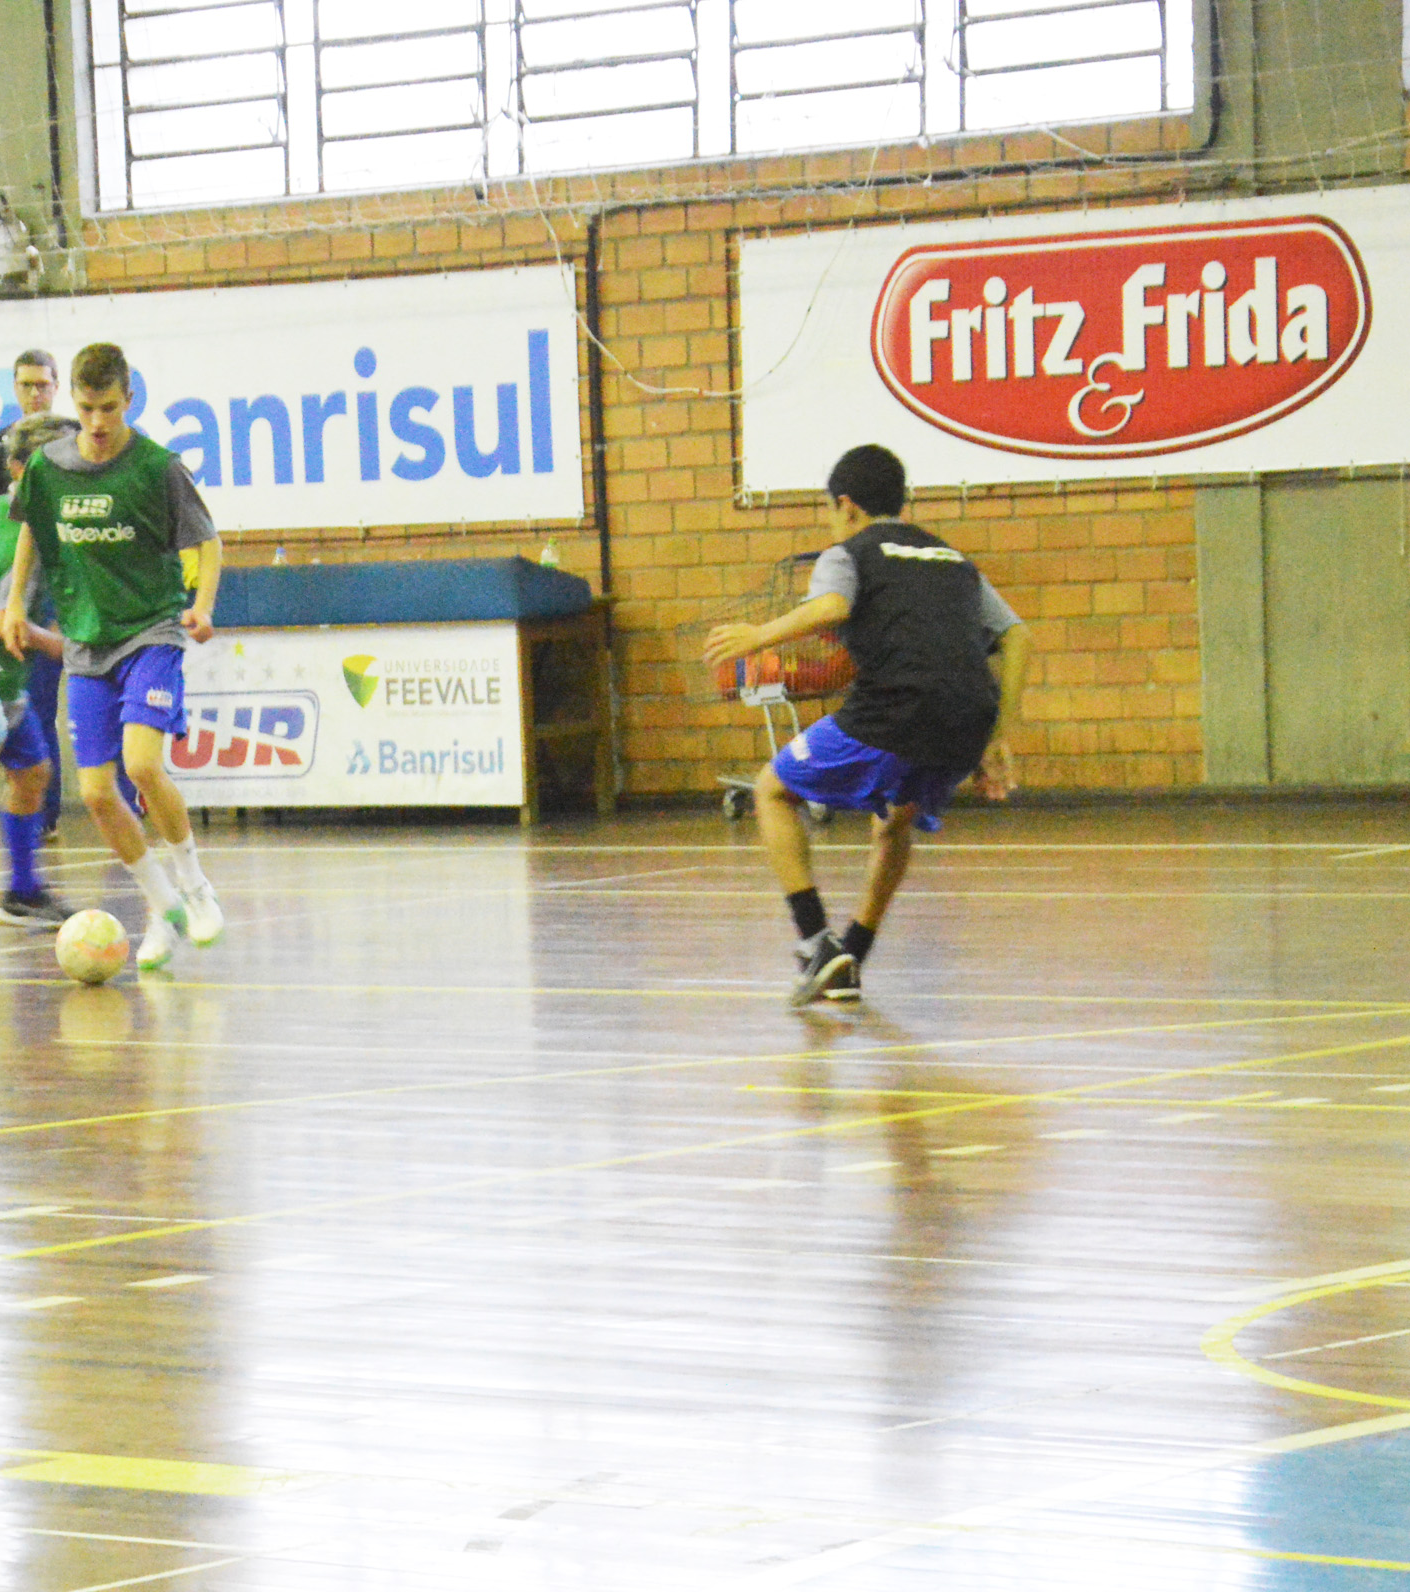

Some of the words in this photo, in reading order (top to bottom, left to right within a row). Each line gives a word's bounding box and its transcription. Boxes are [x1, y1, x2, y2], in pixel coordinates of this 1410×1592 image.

[909, 276, 1085, 386] Fritz
[1067, 352, 1145, 438] &
[1121, 256, 1330, 371] Frida
[384, 658, 501, 674] UNIVERSIDADE
[385, 676, 503, 706] FEEVALE
[170, 706, 306, 770] UJR
[378, 736, 505, 776] Banrisul
